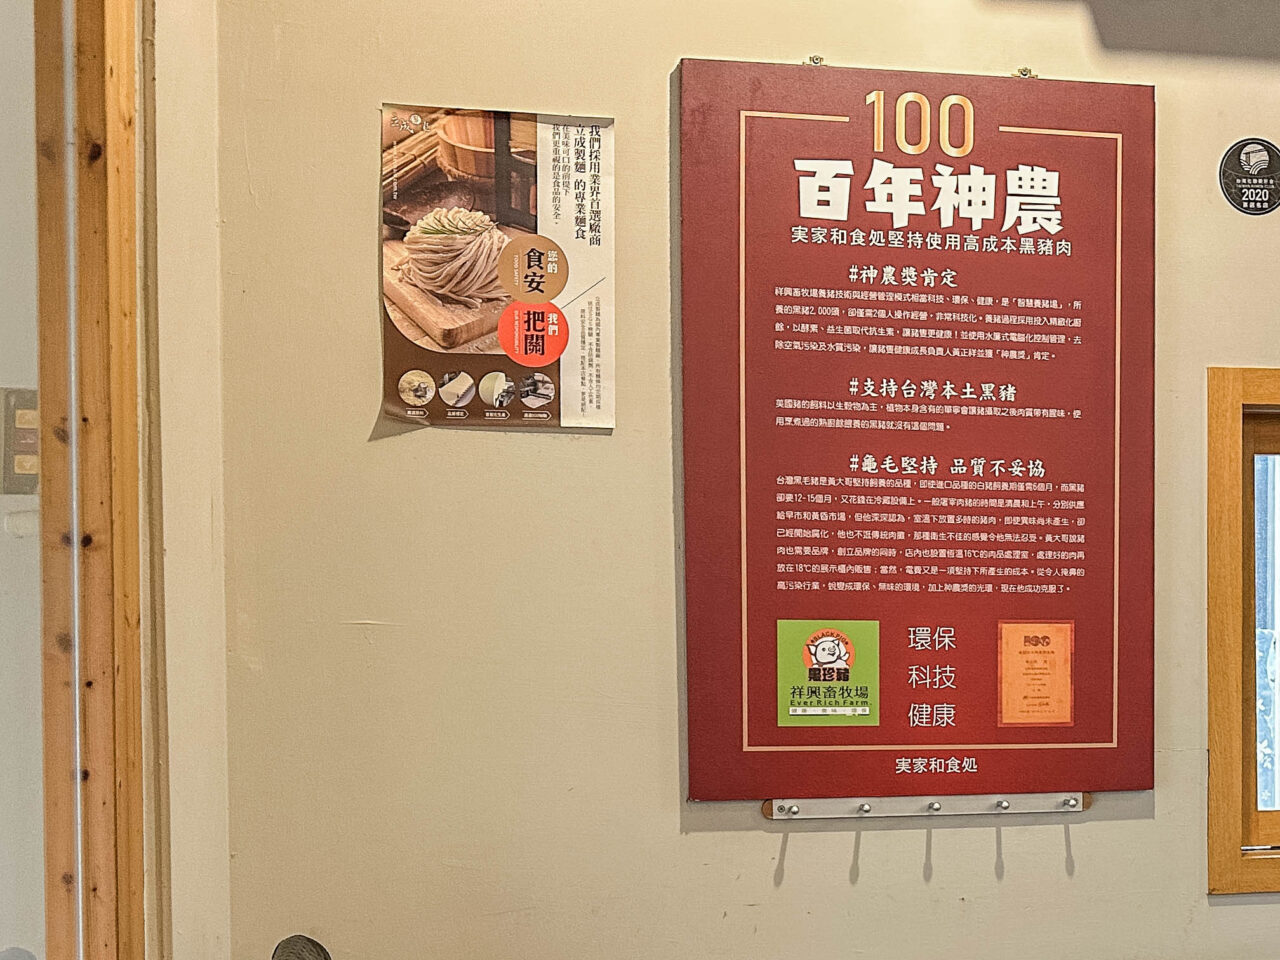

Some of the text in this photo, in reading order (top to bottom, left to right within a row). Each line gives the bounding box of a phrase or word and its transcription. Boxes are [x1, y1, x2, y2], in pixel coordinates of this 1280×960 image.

[865, 89, 975, 158] 100
[794, 158, 1064, 236] 百年神農
[1242, 188, 1269, 201] 2020
[790, 225, 1073, 257] 実家和食処堅持使用高成本黑豬肉
[523, 248, 546, 294] 食安
[547, 250, 558, 274] 您的
[848, 264, 958, 288] #神農獎肯定
[523, 310, 546, 356] 把關
[547, 313, 559, 336] 我們
[848, 377, 1017, 402] #支持台灣本土黑豬
[849, 454, 1046, 478] #龜毛堅持 品質不妥協
[908, 626, 956, 651] 環保
[908, 664, 957, 690] 科技
[790, 685, 869, 699] 祥興畜牧場
[908, 703, 956, 728] 健康
[895, 756, 978, 774] 実家和食処
